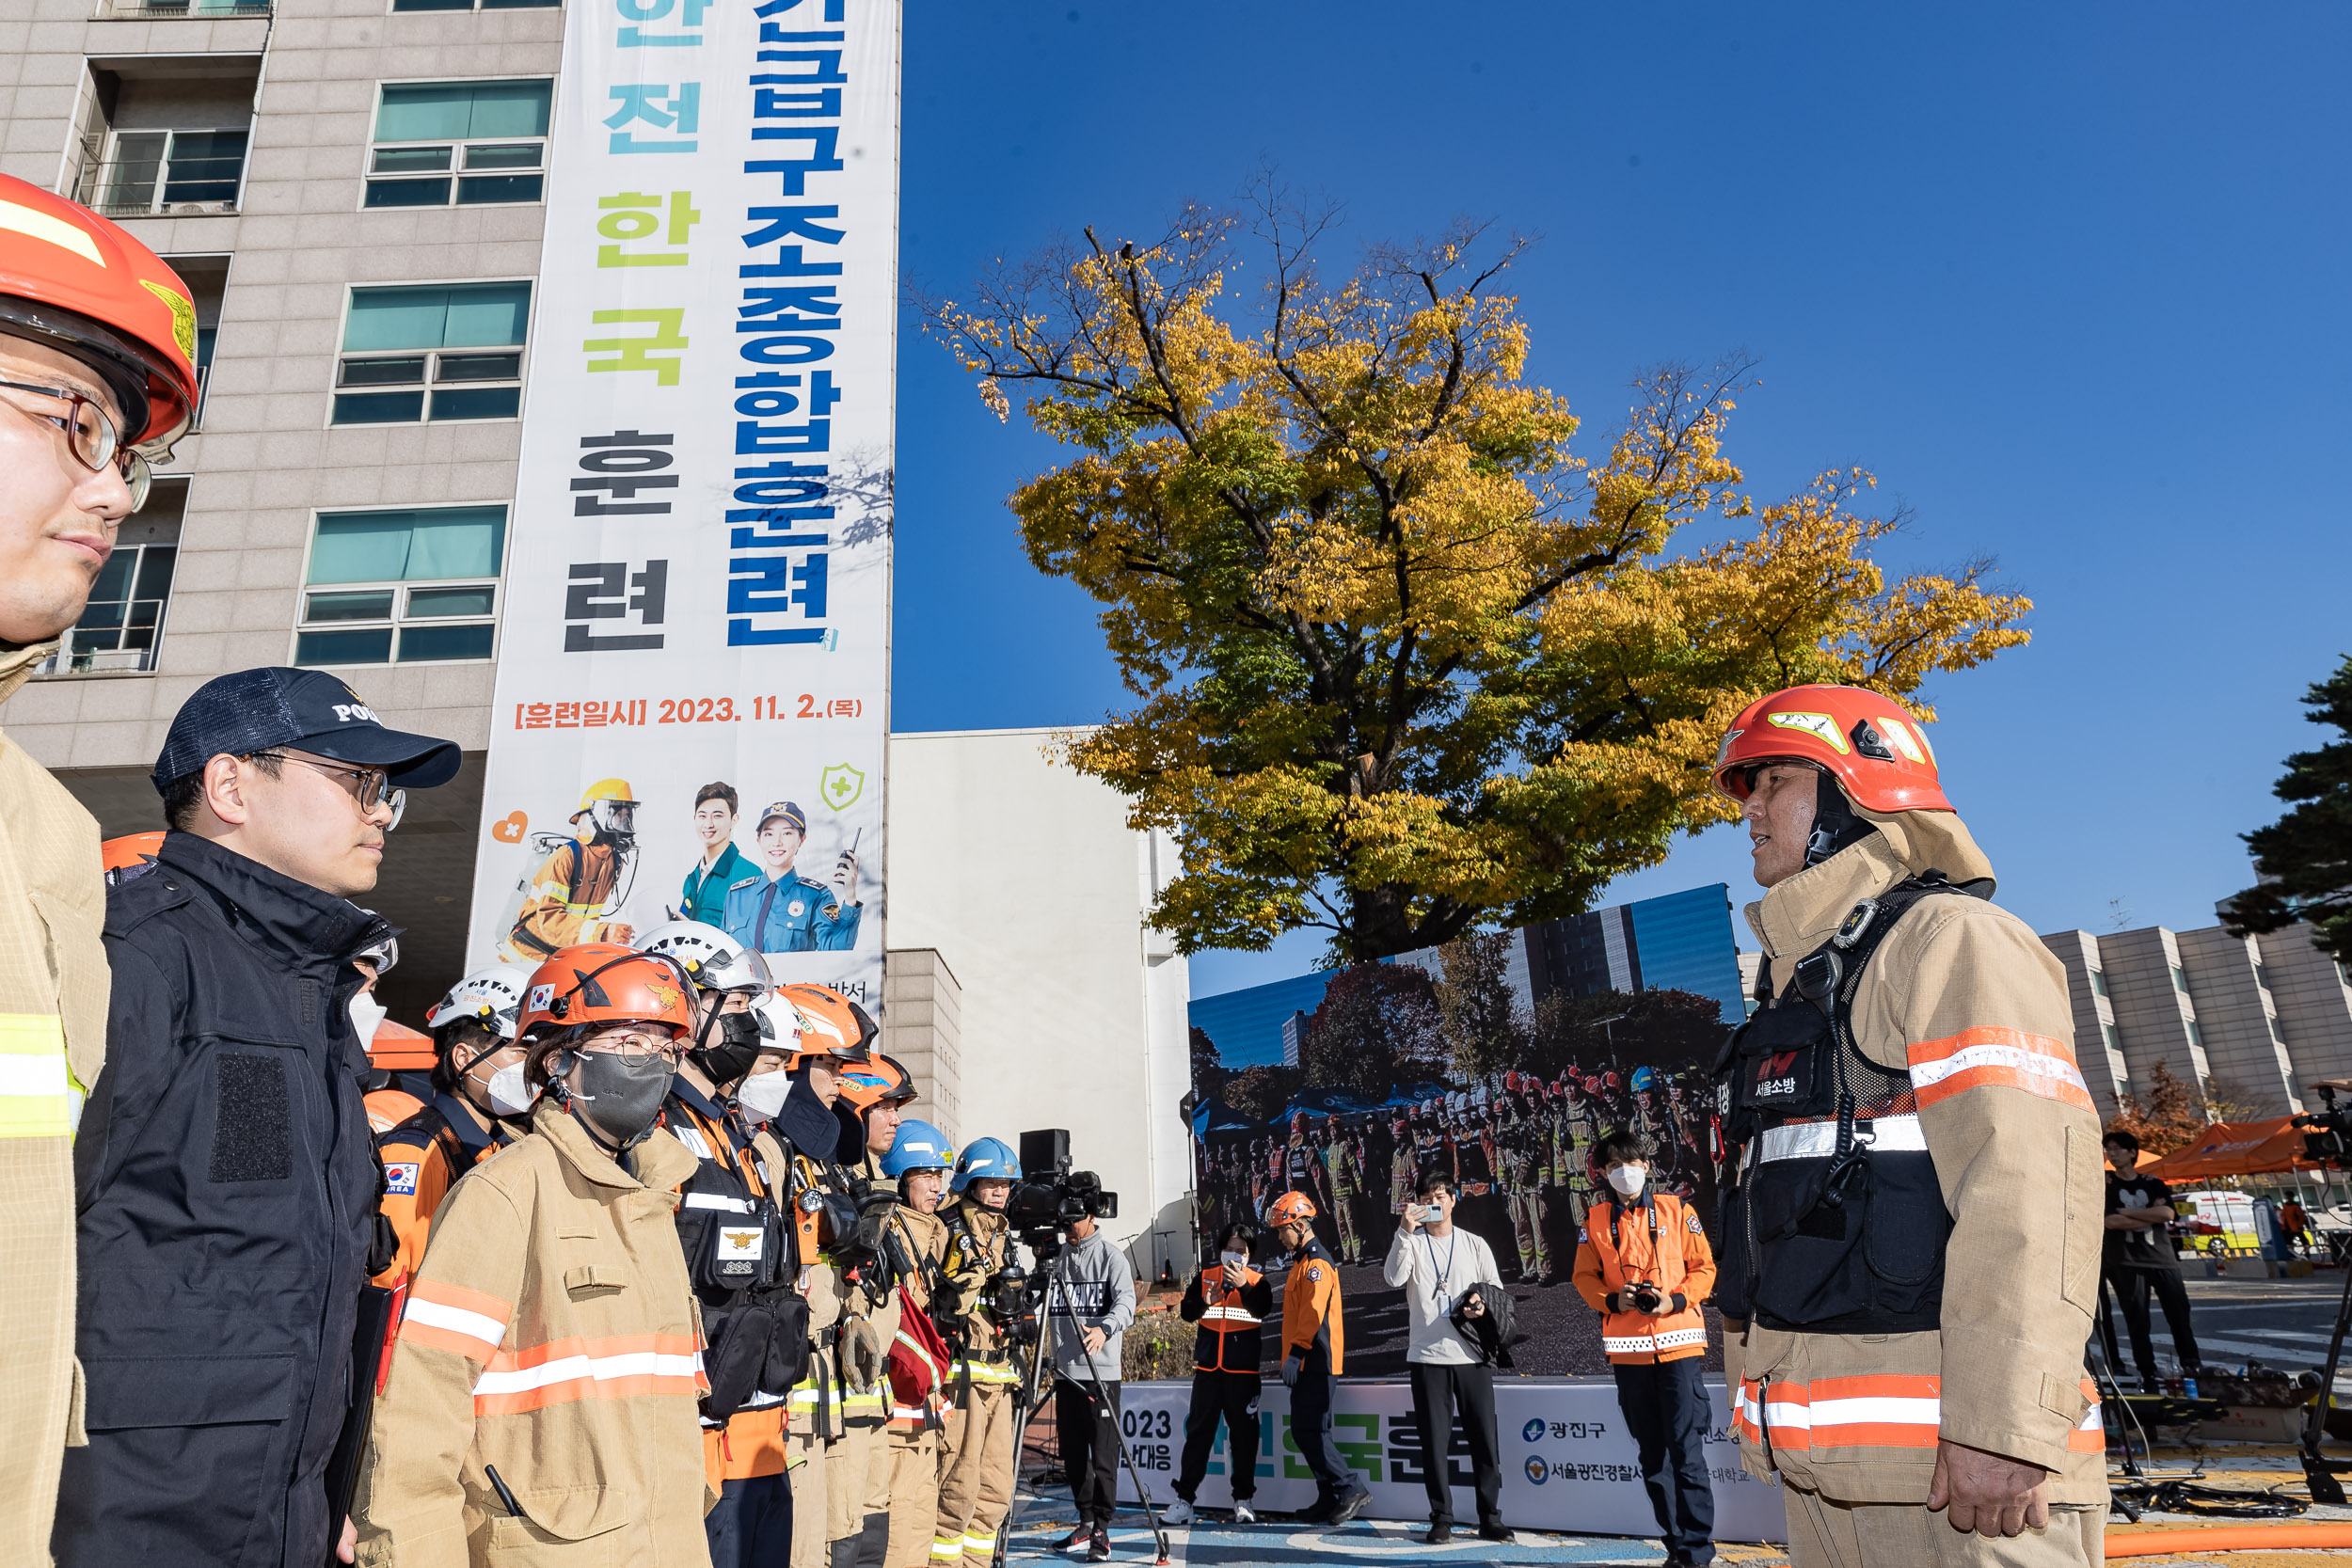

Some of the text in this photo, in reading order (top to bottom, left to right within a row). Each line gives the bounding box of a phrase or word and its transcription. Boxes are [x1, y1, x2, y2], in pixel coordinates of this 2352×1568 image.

[516, 699, 646, 730] [훈련일시]
[659, 698, 742, 724] 2023.
[755, 696, 786, 721] 11.
[1755, 1077, 1796, 1098] 서울소방
[1122, 1409, 1172, 1439] 023
[1549, 1422, 1607, 1439] 광진구
[1119, 1443, 1172, 1471] 난대응
[1709, 1467, 1751, 1484] 대학교
